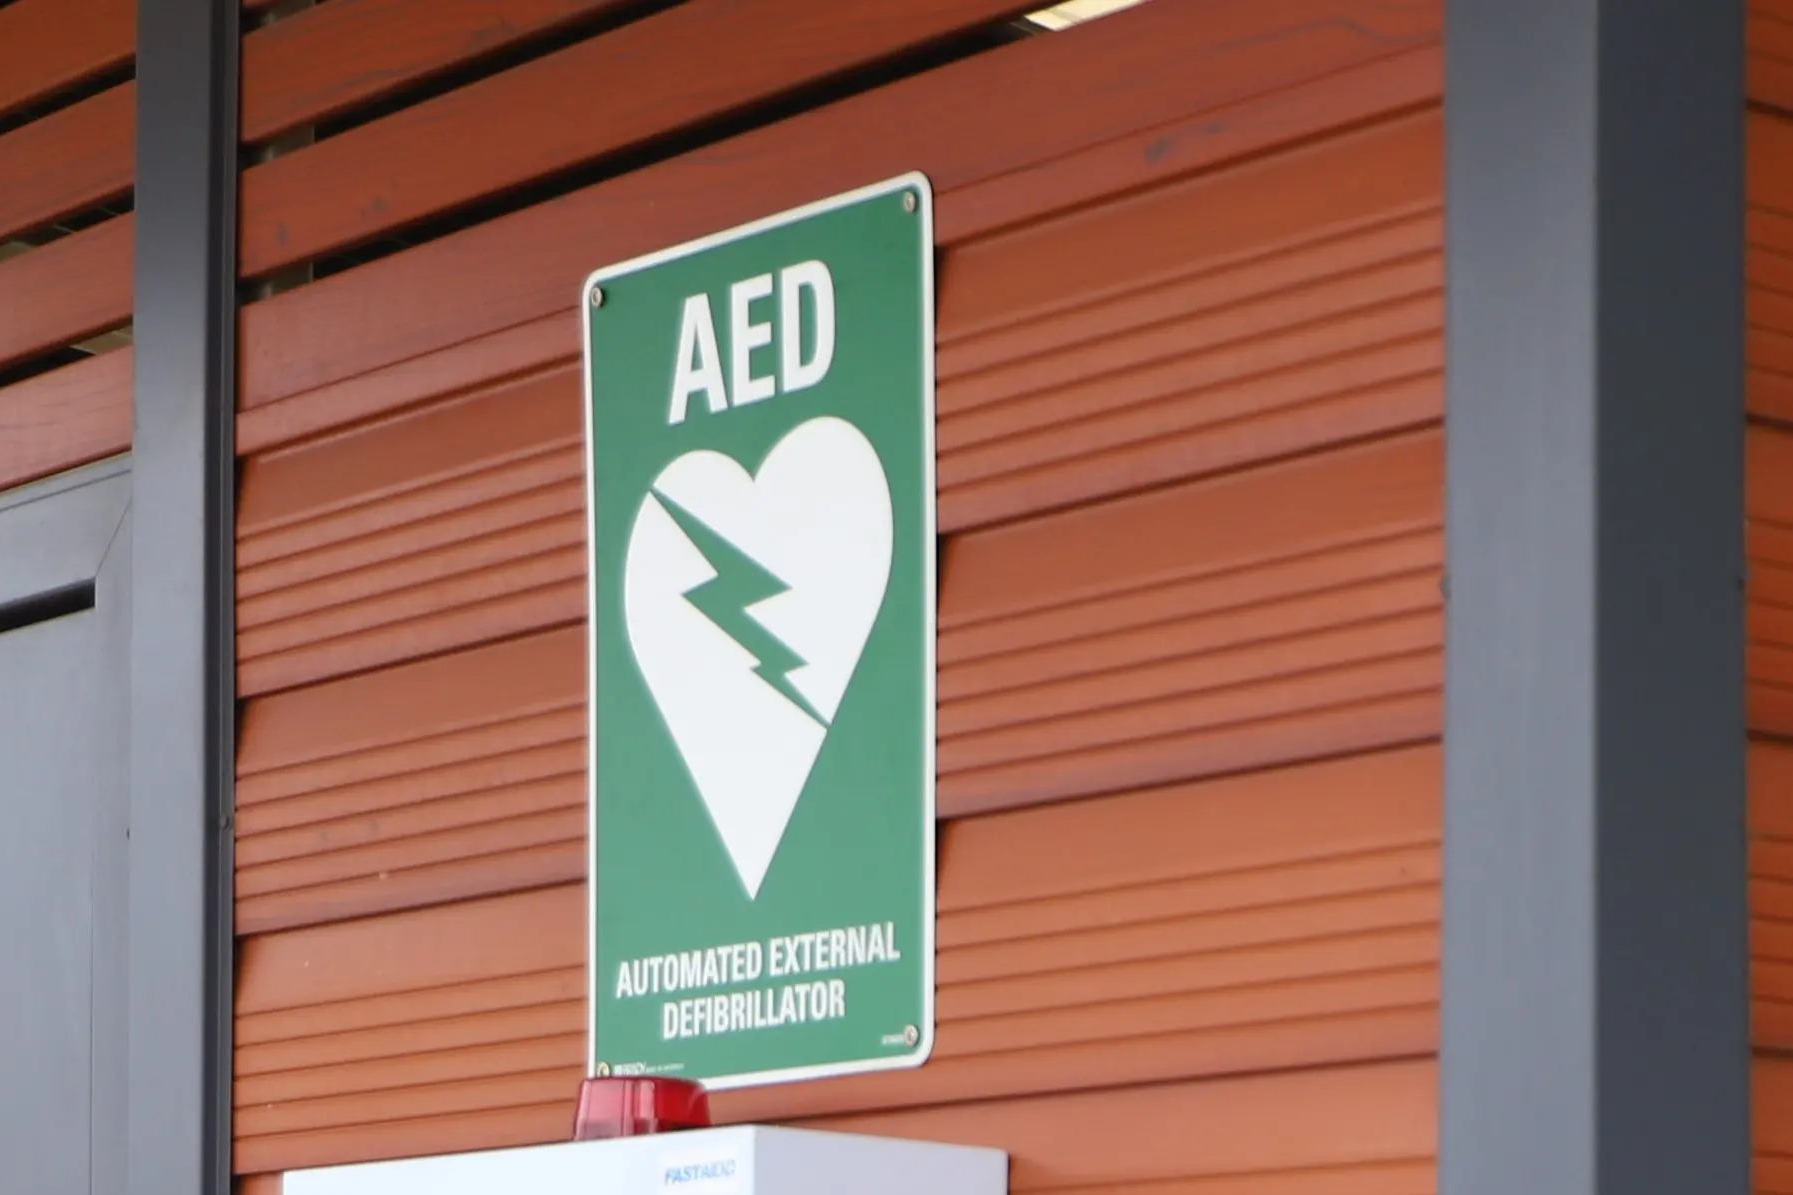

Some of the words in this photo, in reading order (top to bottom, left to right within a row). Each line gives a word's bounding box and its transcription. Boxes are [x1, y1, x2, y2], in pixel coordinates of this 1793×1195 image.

[667, 259, 835, 427] AED
[615, 941, 763, 998] AUTOMATED
[769, 921, 901, 977] EXTERNAL
[662, 979, 846, 1040] DEFIBRILLATOR
